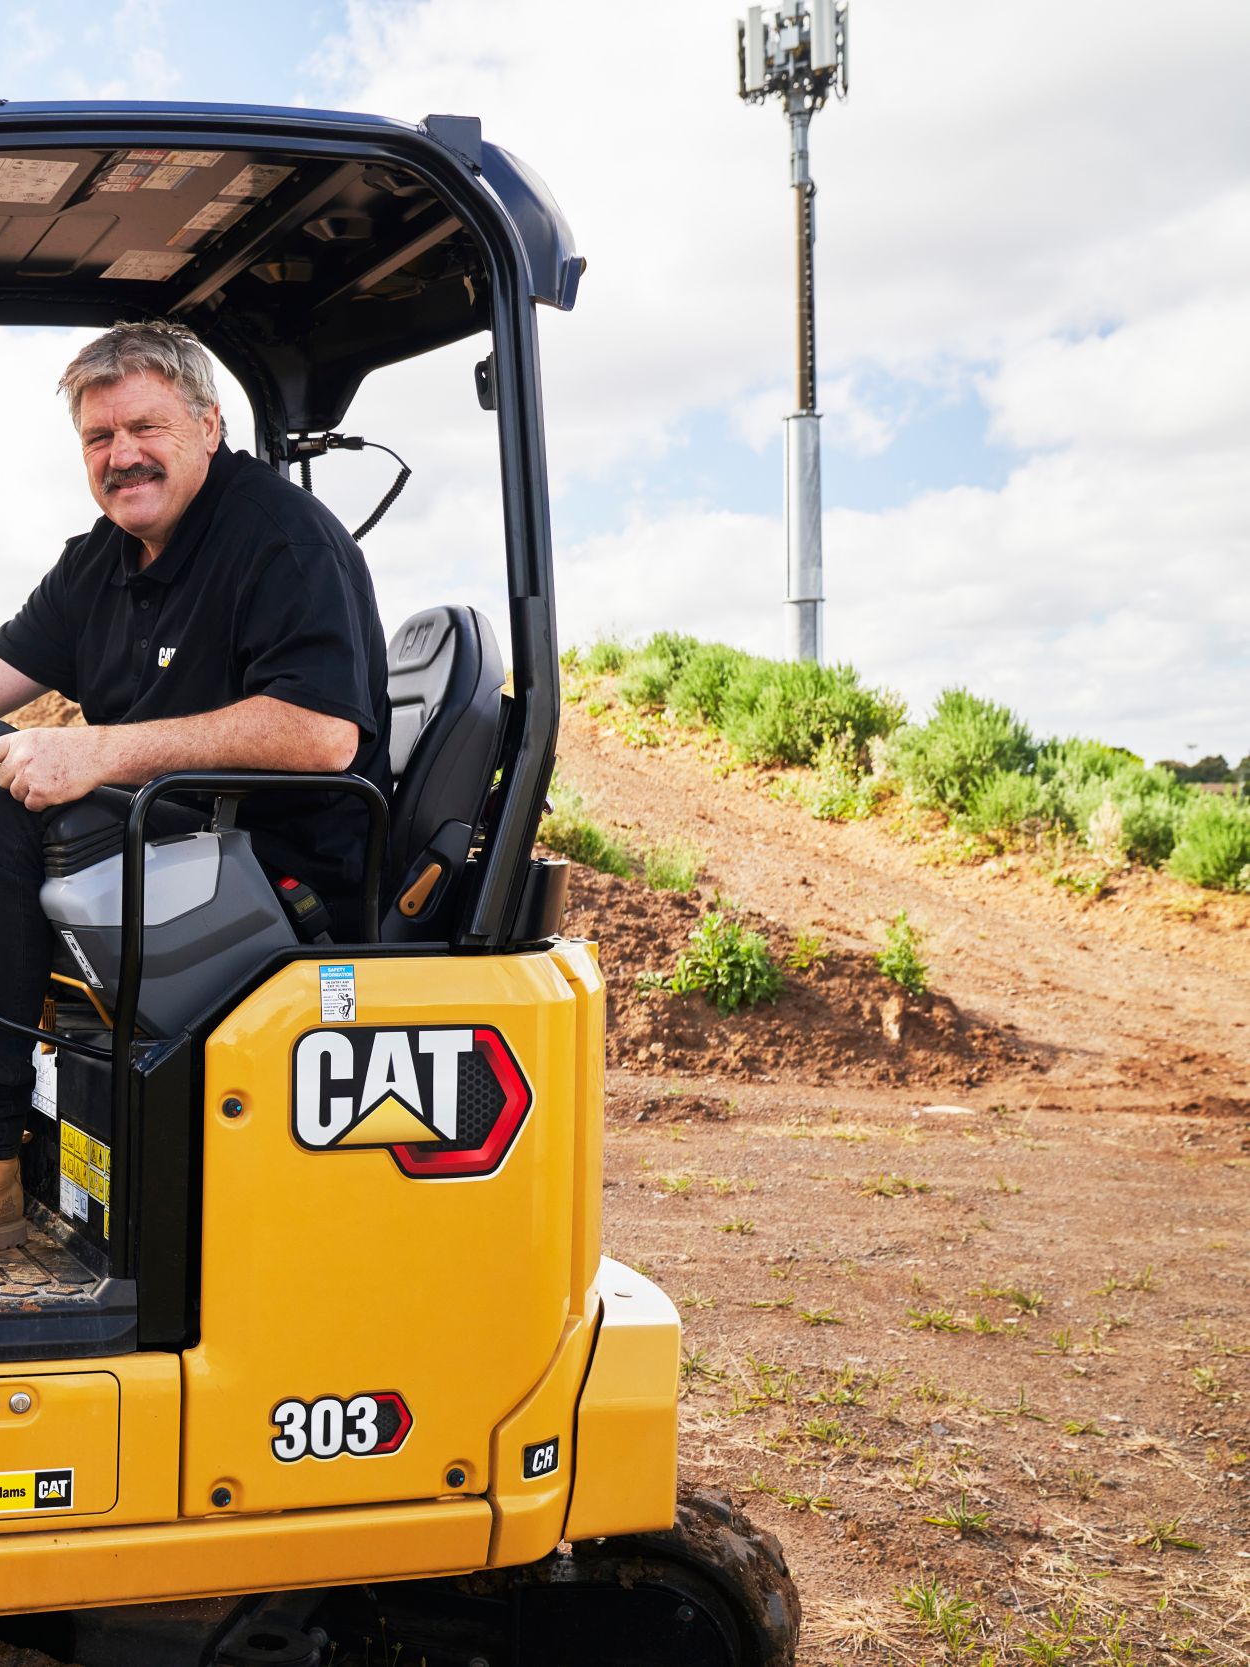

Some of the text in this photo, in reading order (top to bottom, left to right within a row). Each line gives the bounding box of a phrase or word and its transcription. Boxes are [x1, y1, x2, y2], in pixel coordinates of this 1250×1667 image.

[296, 1029, 474, 1146] CAT
[274, 1396, 379, 1459] 303
[531, 1444, 554, 1473] CR
[38, 1479, 68, 1499] CAT
